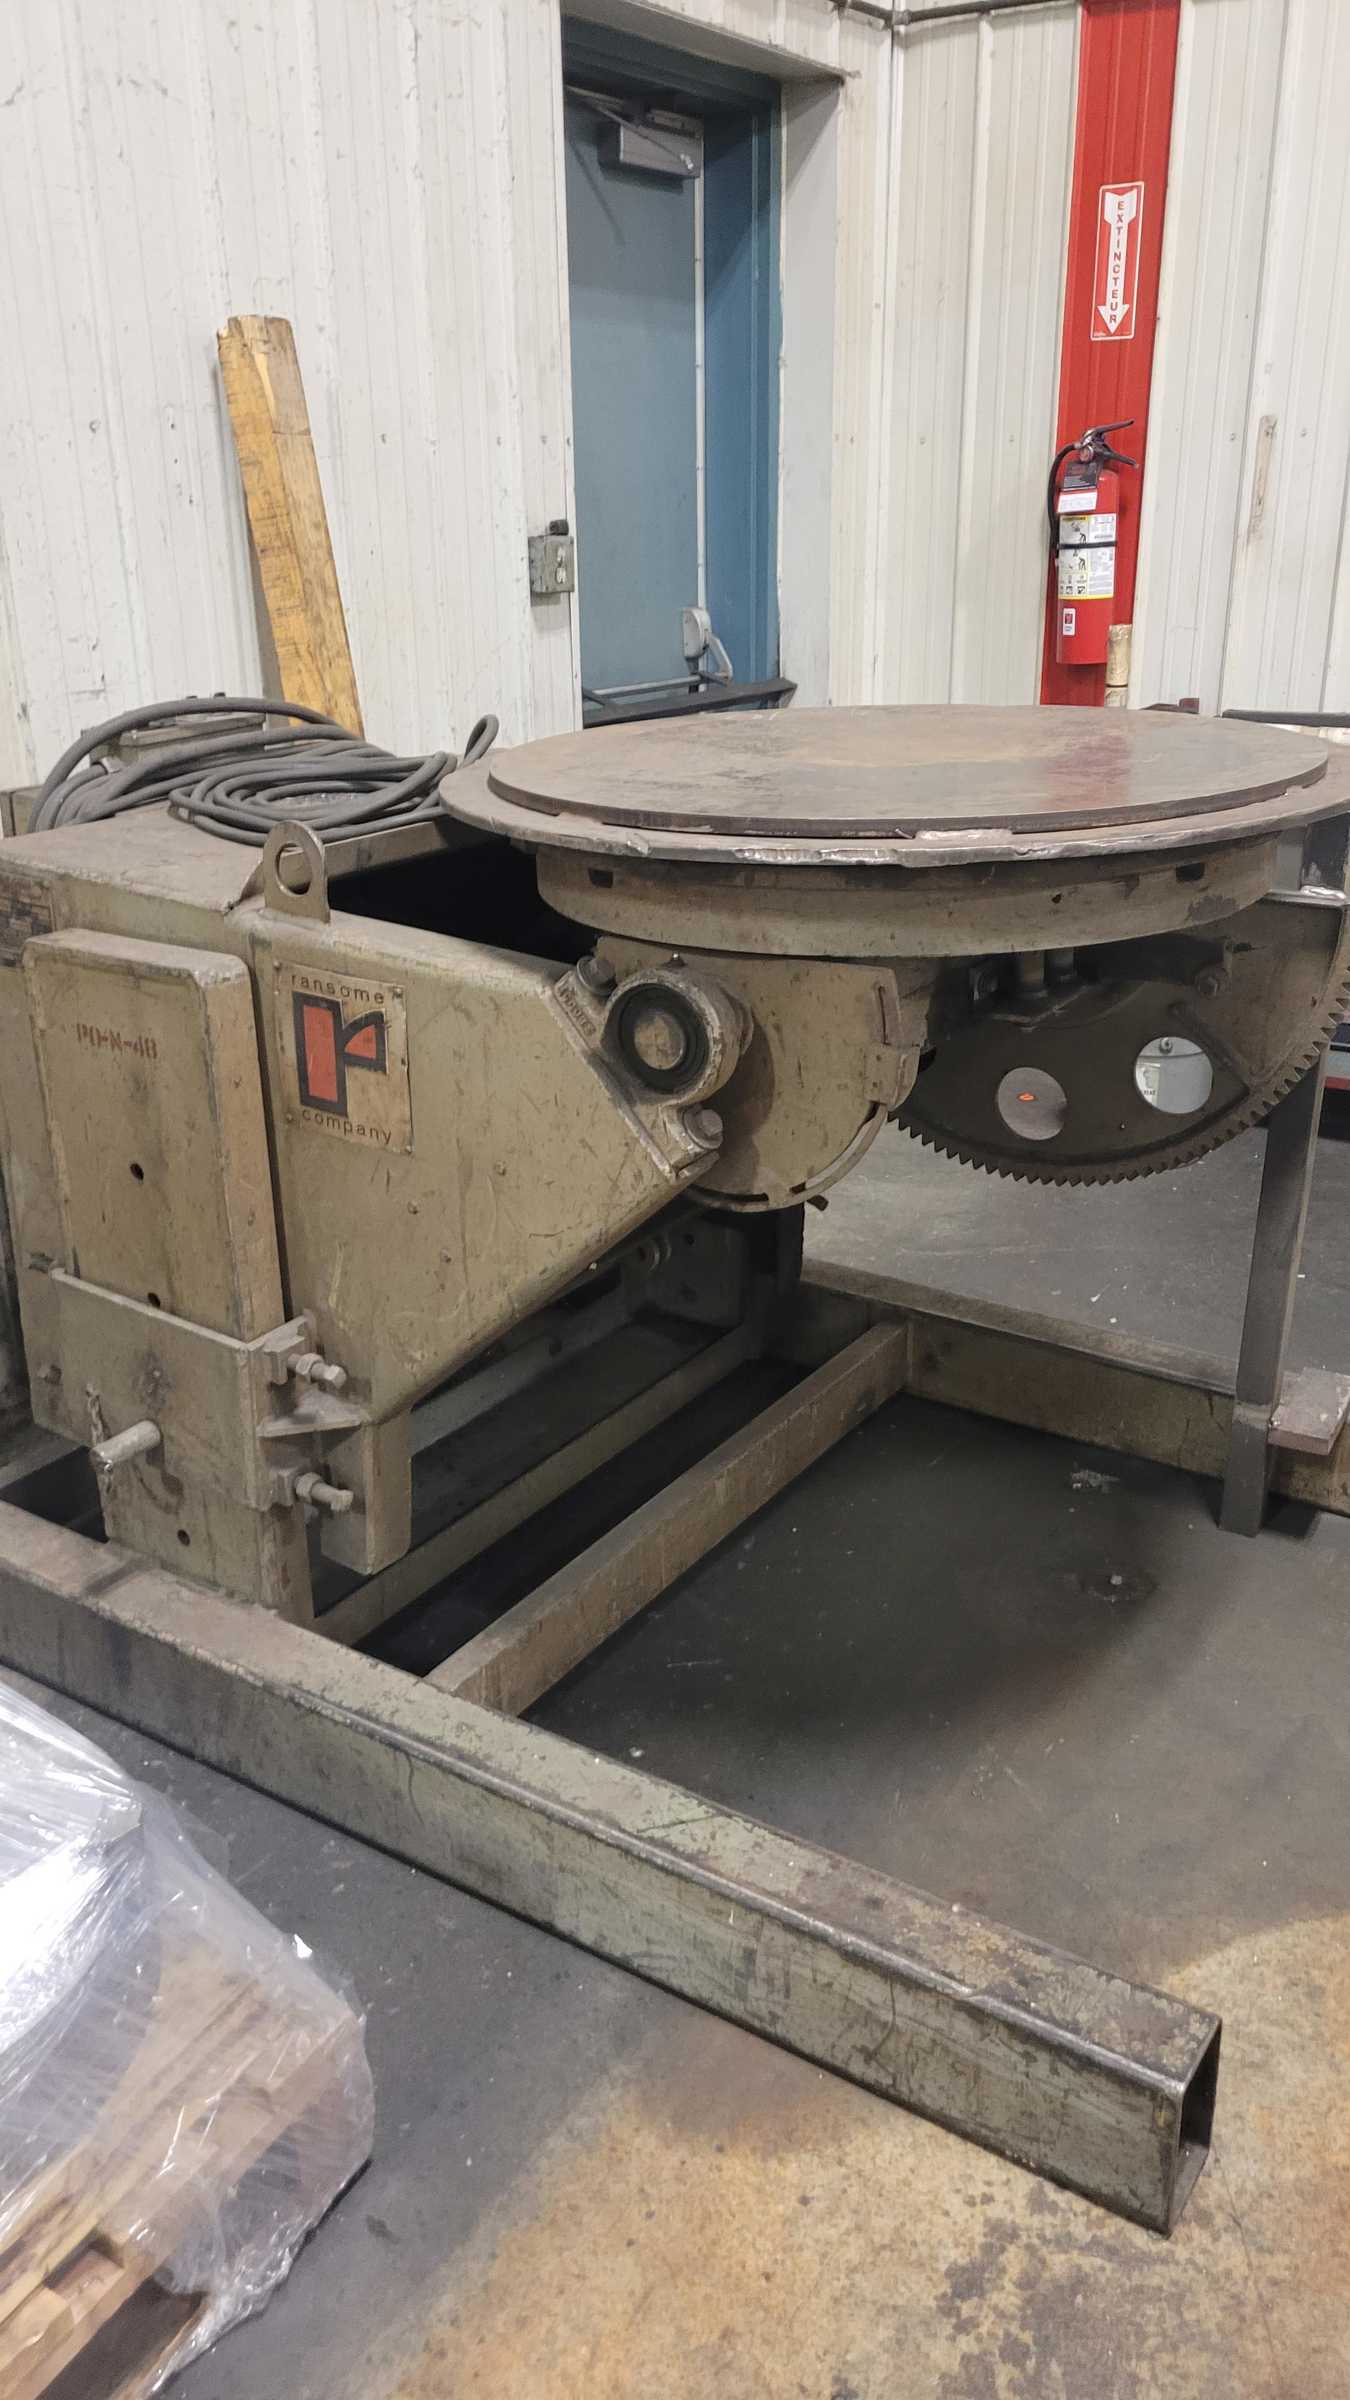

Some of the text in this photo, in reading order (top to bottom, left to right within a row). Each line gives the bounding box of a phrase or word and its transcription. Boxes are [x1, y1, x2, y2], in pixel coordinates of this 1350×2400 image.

[1109, 200, 1125, 324] EXTINCTEUR
[291, 974, 385, 1004] ransome
[302, 1108, 392, 1144] company
